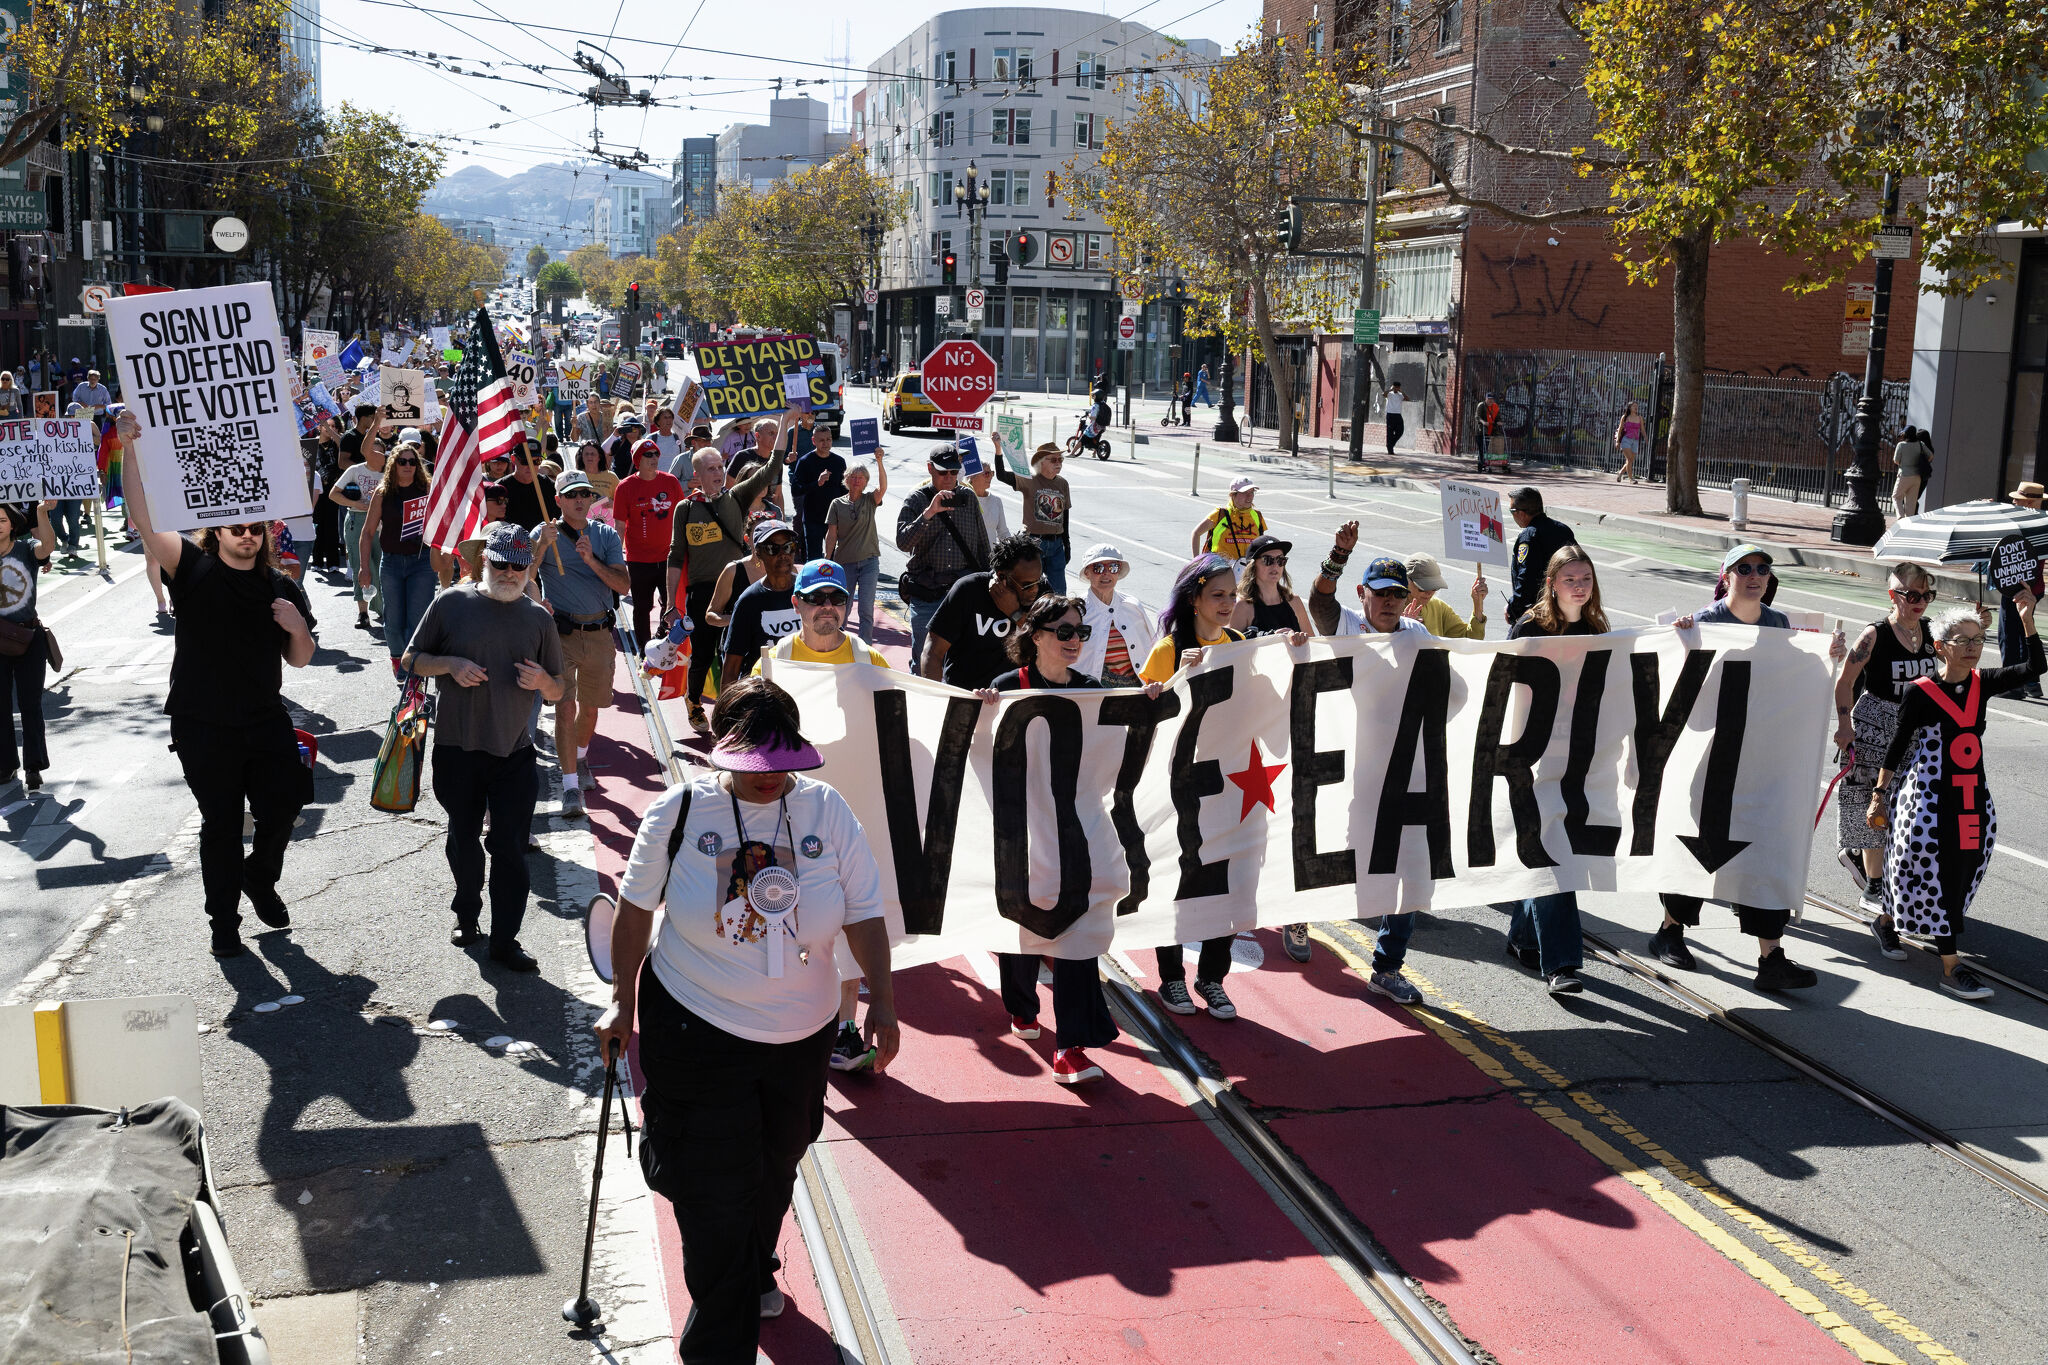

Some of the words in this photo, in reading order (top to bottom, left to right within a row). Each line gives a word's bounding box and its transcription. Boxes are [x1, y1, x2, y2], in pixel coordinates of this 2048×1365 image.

[0, 211, 43, 224] ENTER
[140, 305, 210, 348] SIGN
[212, 301, 251, 340] UP
[126, 352, 167, 389] TO
[168, 339, 276, 386] DEFEND
[511, 353, 526, 363] YES
[526, 358, 537, 366] ON
[699, 338, 814, 369] DEMAND
[945, 350, 975, 366] NO
[507, 363, 534, 384] 40
[725, 364, 793, 386] DUE
[926, 375, 993, 392] KINGS!
[560, 389, 589, 400] KINGS
[567, 381, 580, 389] NO
[138, 388, 196, 428] THE
[197, 378, 279, 421] VOTE!
[708, 377, 829, 415] PROCS
[0, 420, 33, 442] OTE
[44, 420, 81, 438] OUT
[935, 417, 953, 427] ALL
[956, 418, 980, 428] WAYS
[0, 445, 22, 457] ose
[25, 439, 52, 454] who
[54, 438, 77, 453] kiss
[77, 438, 94, 453] his
[0, 469, 8, 480] e
[37, 455, 94, 480] People
[0, 482, 36, 500] erve
[42, 476, 61, 497] No
[61, 475, 96, 497] King!
[1447, 496, 1500, 521] ENOUGH!
[1999, 540, 2025, 556] DON'T
[2000, 550, 2028, 567] ELECT
[1994, 558, 2037, 579] UNHINGED
[1999, 571, 2035, 588] PEOPLE.
[769, 619, 802, 634] VOT
[975, 613, 1011, 638] VO
[1910, 668, 1982, 850] VOTE
[873, 665, 1234, 940] VOTE
[1290, 648, 1717, 892] EARLY
